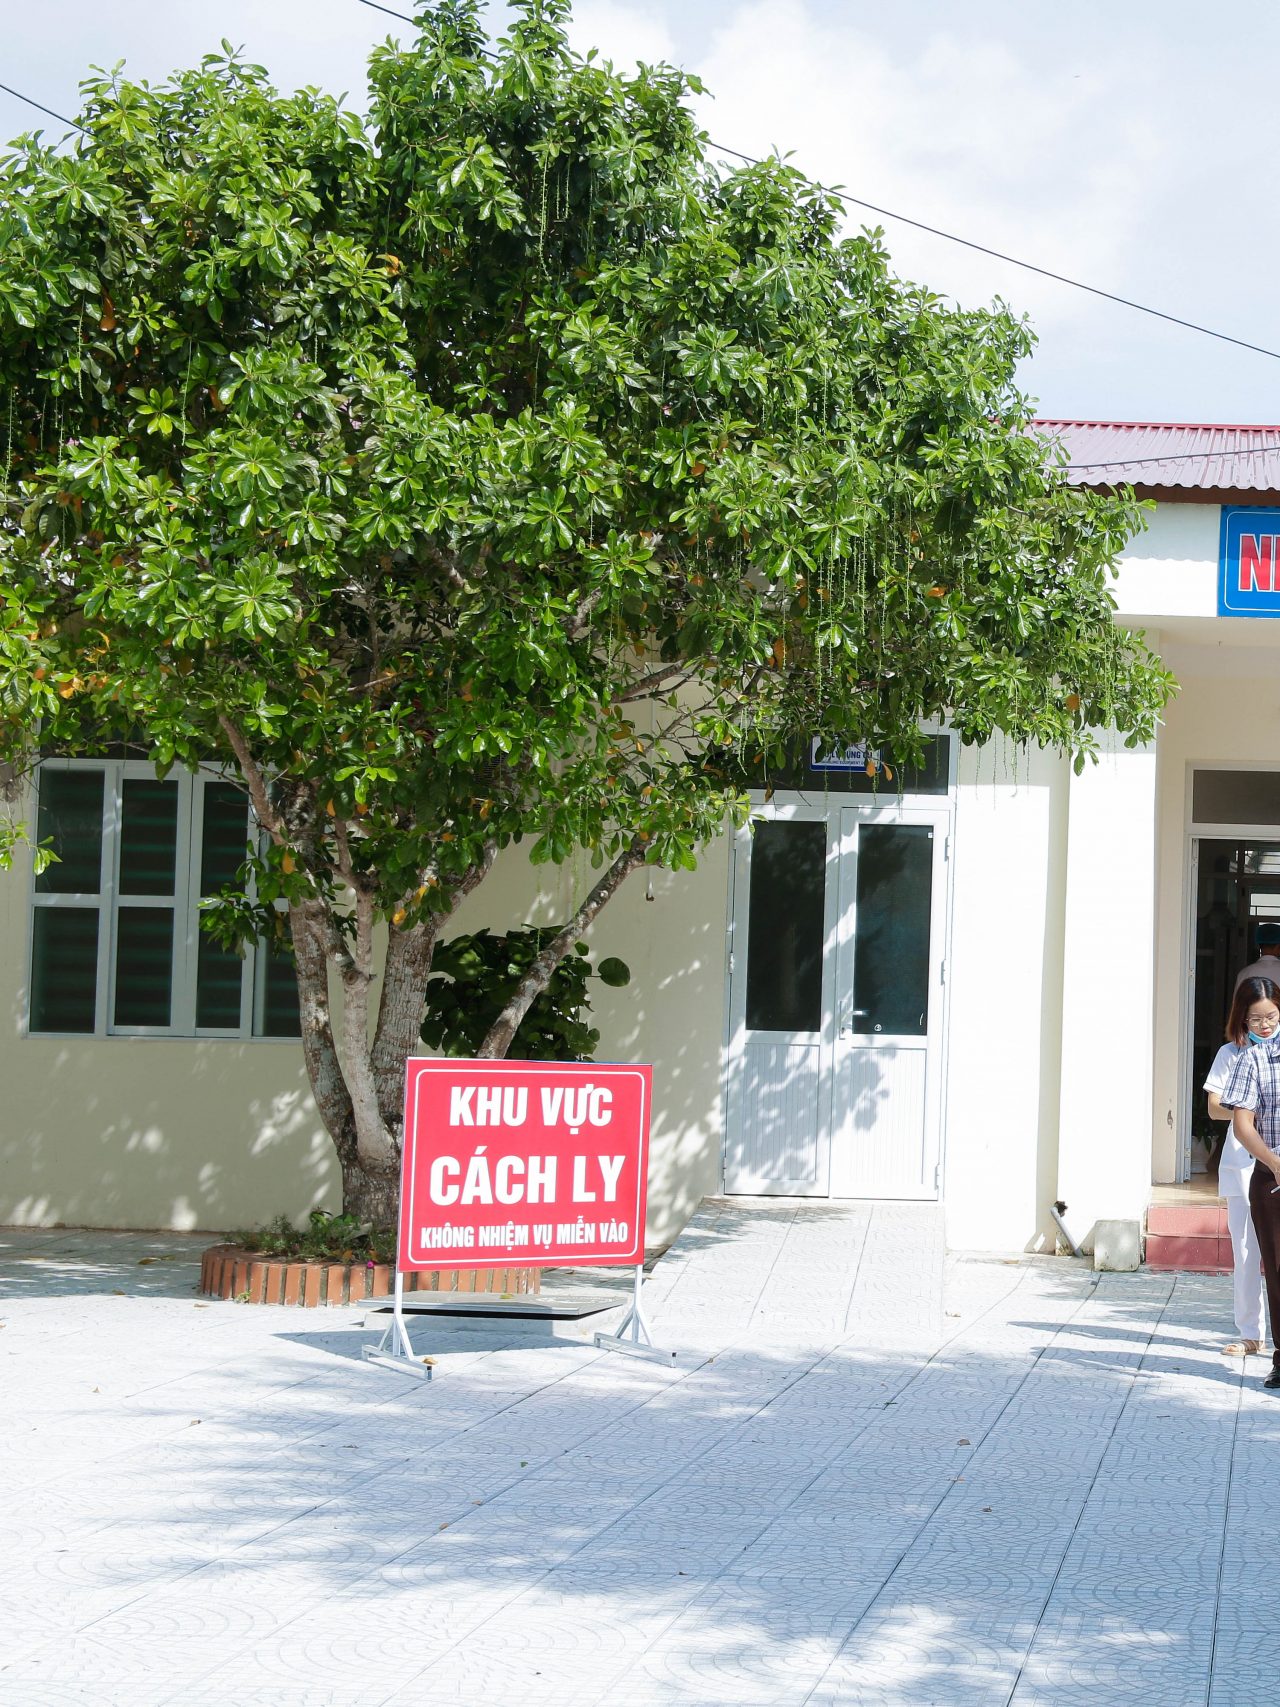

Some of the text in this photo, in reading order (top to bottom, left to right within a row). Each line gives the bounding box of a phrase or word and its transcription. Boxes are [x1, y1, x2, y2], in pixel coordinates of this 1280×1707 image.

[450, 1083, 613, 1135] KHU VỰC
[430, 1146, 626, 1206] CÁCH LY
[420, 1216, 628, 1251] KHÔNG NHIỆM VỤ MIỄN VÀO
